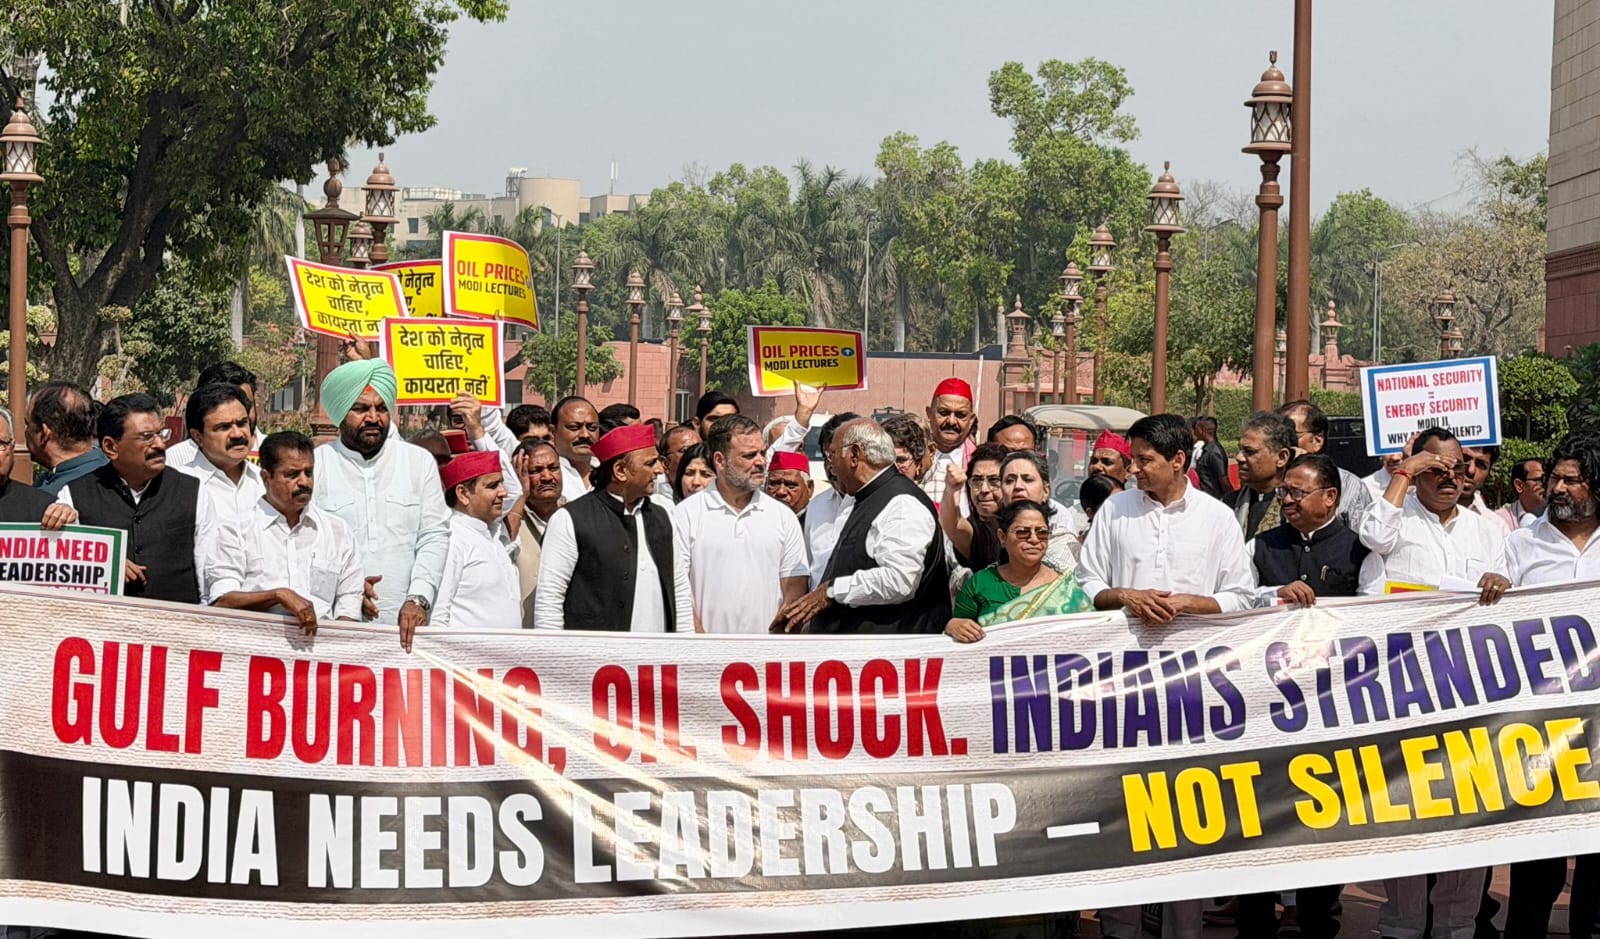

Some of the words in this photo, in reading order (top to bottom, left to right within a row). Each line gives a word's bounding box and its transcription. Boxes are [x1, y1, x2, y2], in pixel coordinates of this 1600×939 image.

[304, 268, 326, 288] देश
[327, 274, 345, 292] को
[346, 276, 384, 300] नेतृत्व
[404, 269, 435, 295] नेतृत्व
[457, 259, 479, 277] OIL
[484, 262, 525, 285] PRICES
[458, 279, 482, 292] MODI
[485, 282, 526, 299] LECTURES
[326, 294, 368, 315] चाहिए,
[314, 310, 362, 333] कायरता
[399, 326, 423, 346] देश
[426, 326, 445, 346] को
[448, 327, 485, 355] नेतृत्व
[762, 345, 785, 358] OIL
[789, 345, 840, 358] PRICES
[423, 349, 468, 373] चाहिए,
[764, 359, 789, 371] MODI
[792, 358, 839, 369] LECTURES
[403, 377, 460, 394] कायरता
[463, 374, 491, 396] नहीं
[1376, 373, 1430, 392] NATIONAL
[1432, 368, 1483, 387] SECURITY
[1385, 402, 1425, 419] ENERGY
[1429, 397, 1480, 415] SECURITY
[1417, 416, 1440, 429] MODI
[1387, 431, 1408, 444] WHY
[0, 537, 50, 559] NDIA
[56, 538, 109, 563] NEED
[0, 562, 108, 587] EADERSHIP,
[51, 636, 223, 755] GULF
[245, 655, 567, 776] BURNING,
[592, 664, 698, 763] OIL
[720, 657, 968, 763] SHOCK.
[989, 645, 1247, 753] INDIANS
[1265, 614, 1600, 733] STRANDED
[82, 776, 279, 886] INDIA
[307, 792, 545, 889] NEEDS
[573, 783, 1017, 884] LEADERSHIP
[1121, 760, 1262, 853] NOT
[1288, 717, 1600, 830] SILENCE
